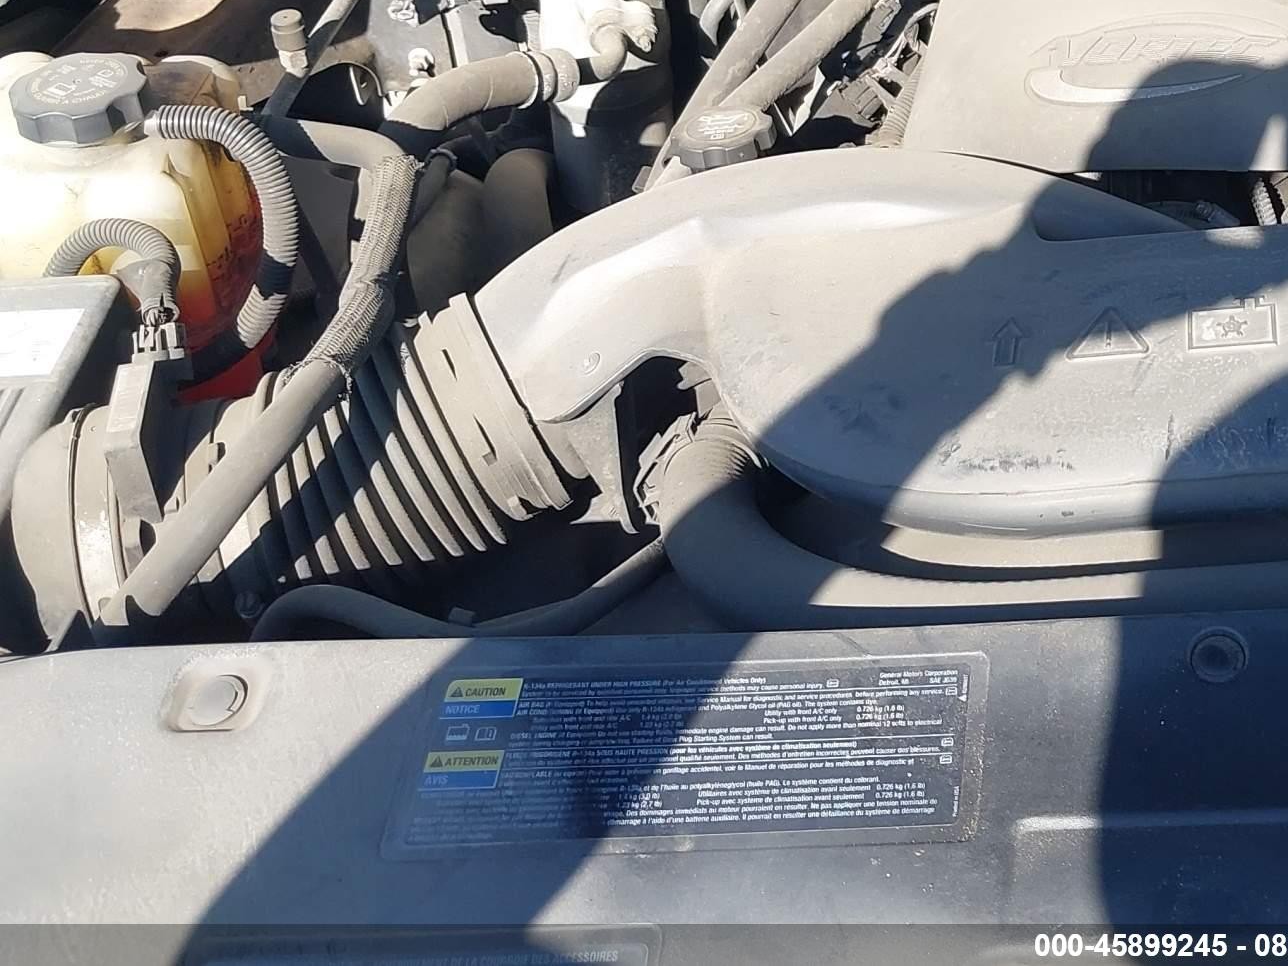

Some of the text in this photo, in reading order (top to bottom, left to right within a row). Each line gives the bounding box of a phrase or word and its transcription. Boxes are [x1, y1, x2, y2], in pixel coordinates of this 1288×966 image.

[465, 687, 506, 697] CAUTION
[720, 685, 744, 693] methods
[875, 689, 907, 697] performing
[817, 699, 838, 707] system
[446, 705, 480, 714] NOTICE
[830, 714, 842, 722] only
[693, 735, 718, 743] Starting
[718, 734, 741, 742] System
[876, 747, 896, 755] causer
[444, 756, 498, 766] ATTENTION
[810, 761, 824, 769] pour
[425, 775, 448, 786] AVIS
[728, 789, 743, 797] avec
[820, 785, 837, 793] avant
[721, 797, 737, 805] avec
[764, 795, 772, 803] de
[773, 794, 813, 803] climatisation
[814, 793, 831, 801] avant
